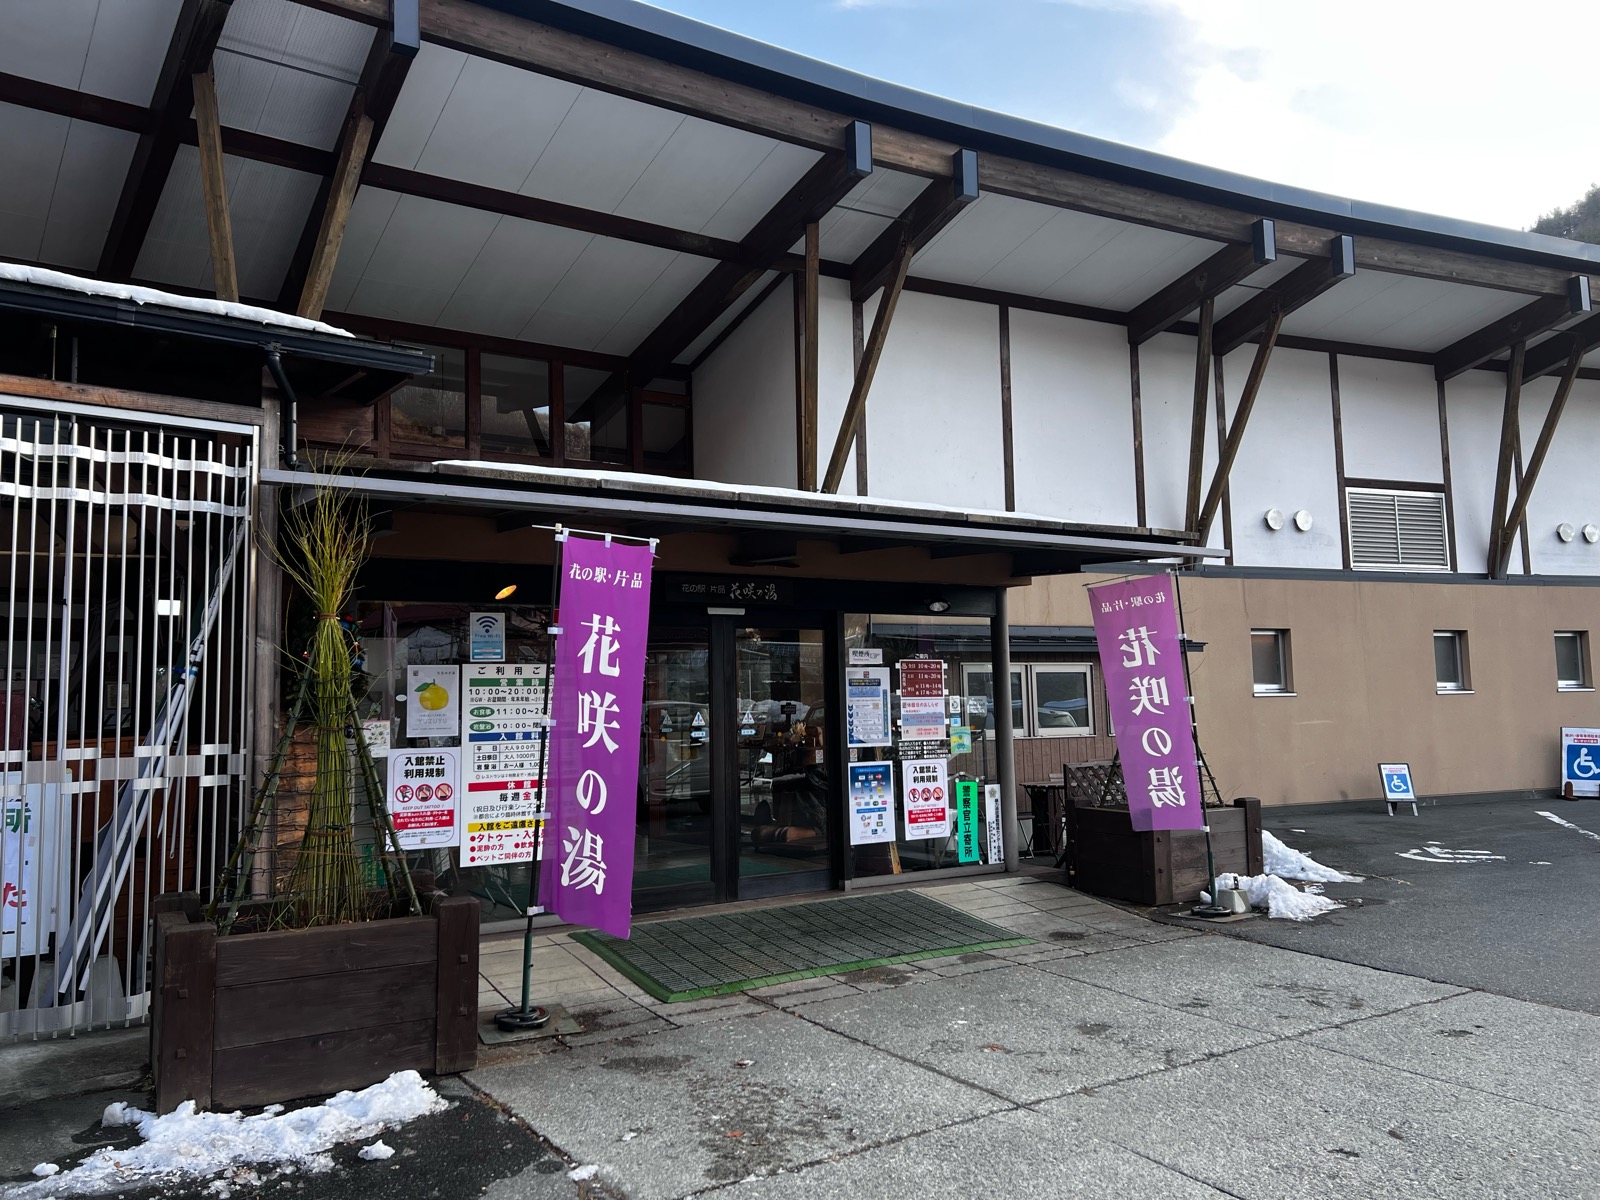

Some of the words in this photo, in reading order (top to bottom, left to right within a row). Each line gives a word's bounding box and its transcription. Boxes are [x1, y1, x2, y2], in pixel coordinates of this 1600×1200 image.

[569, 563, 643, 589] 花の駅・片品
[681, 584, 706, 593] 花の駅
[710, 585, 726, 594] 片品
[561, 613, 621, 895] 花咲の湯
[404, 756, 445, 767] 入館禁止
[404, 768, 445, 779] 利用規制
[913, 765, 938, 774] 入館禁止
[913, 775, 938, 784] 利用規制
[962, 785, 973, 858] 警察官立寄所
[476, 843, 505, 852] 泥酔の方
[476, 850, 532, 862] ペットご同伴の方
